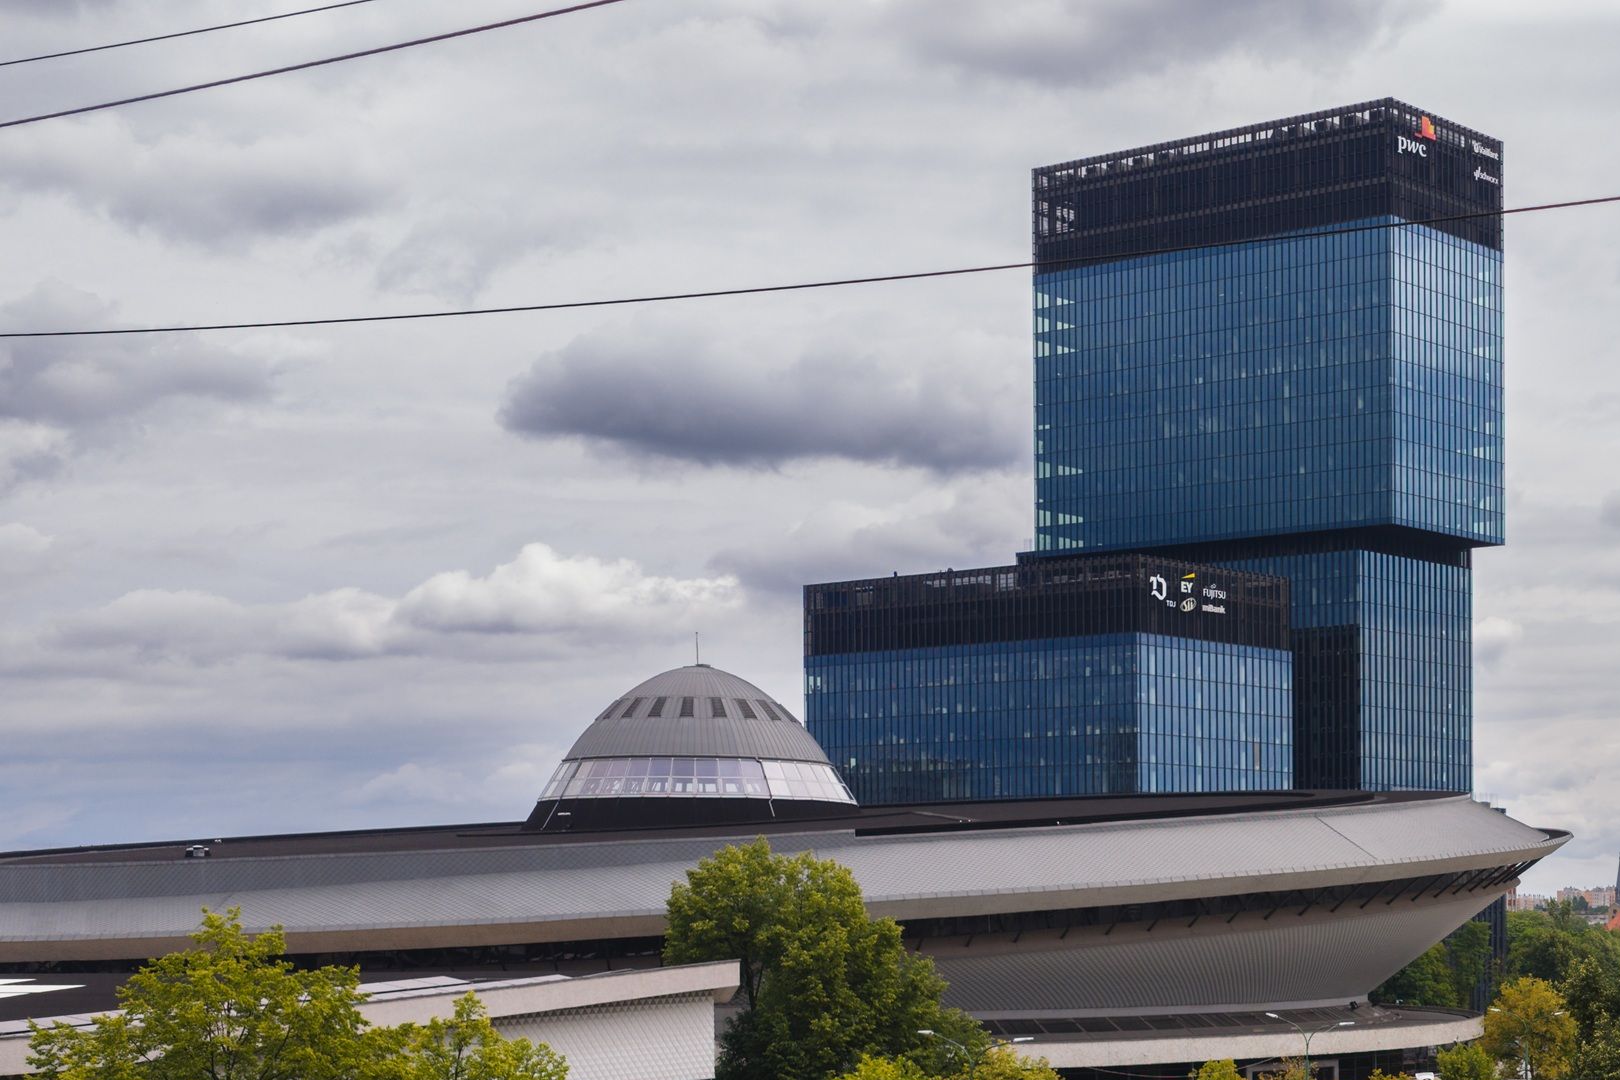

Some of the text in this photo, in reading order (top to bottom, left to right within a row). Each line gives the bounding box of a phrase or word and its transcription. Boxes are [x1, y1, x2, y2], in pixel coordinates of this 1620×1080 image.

[1397, 135, 1427, 157] pwc
[1181, 581, 1193, 593] EY
[1203, 588, 1226, 600] FUJITSU
[1202, 604, 1226, 614] mBank
